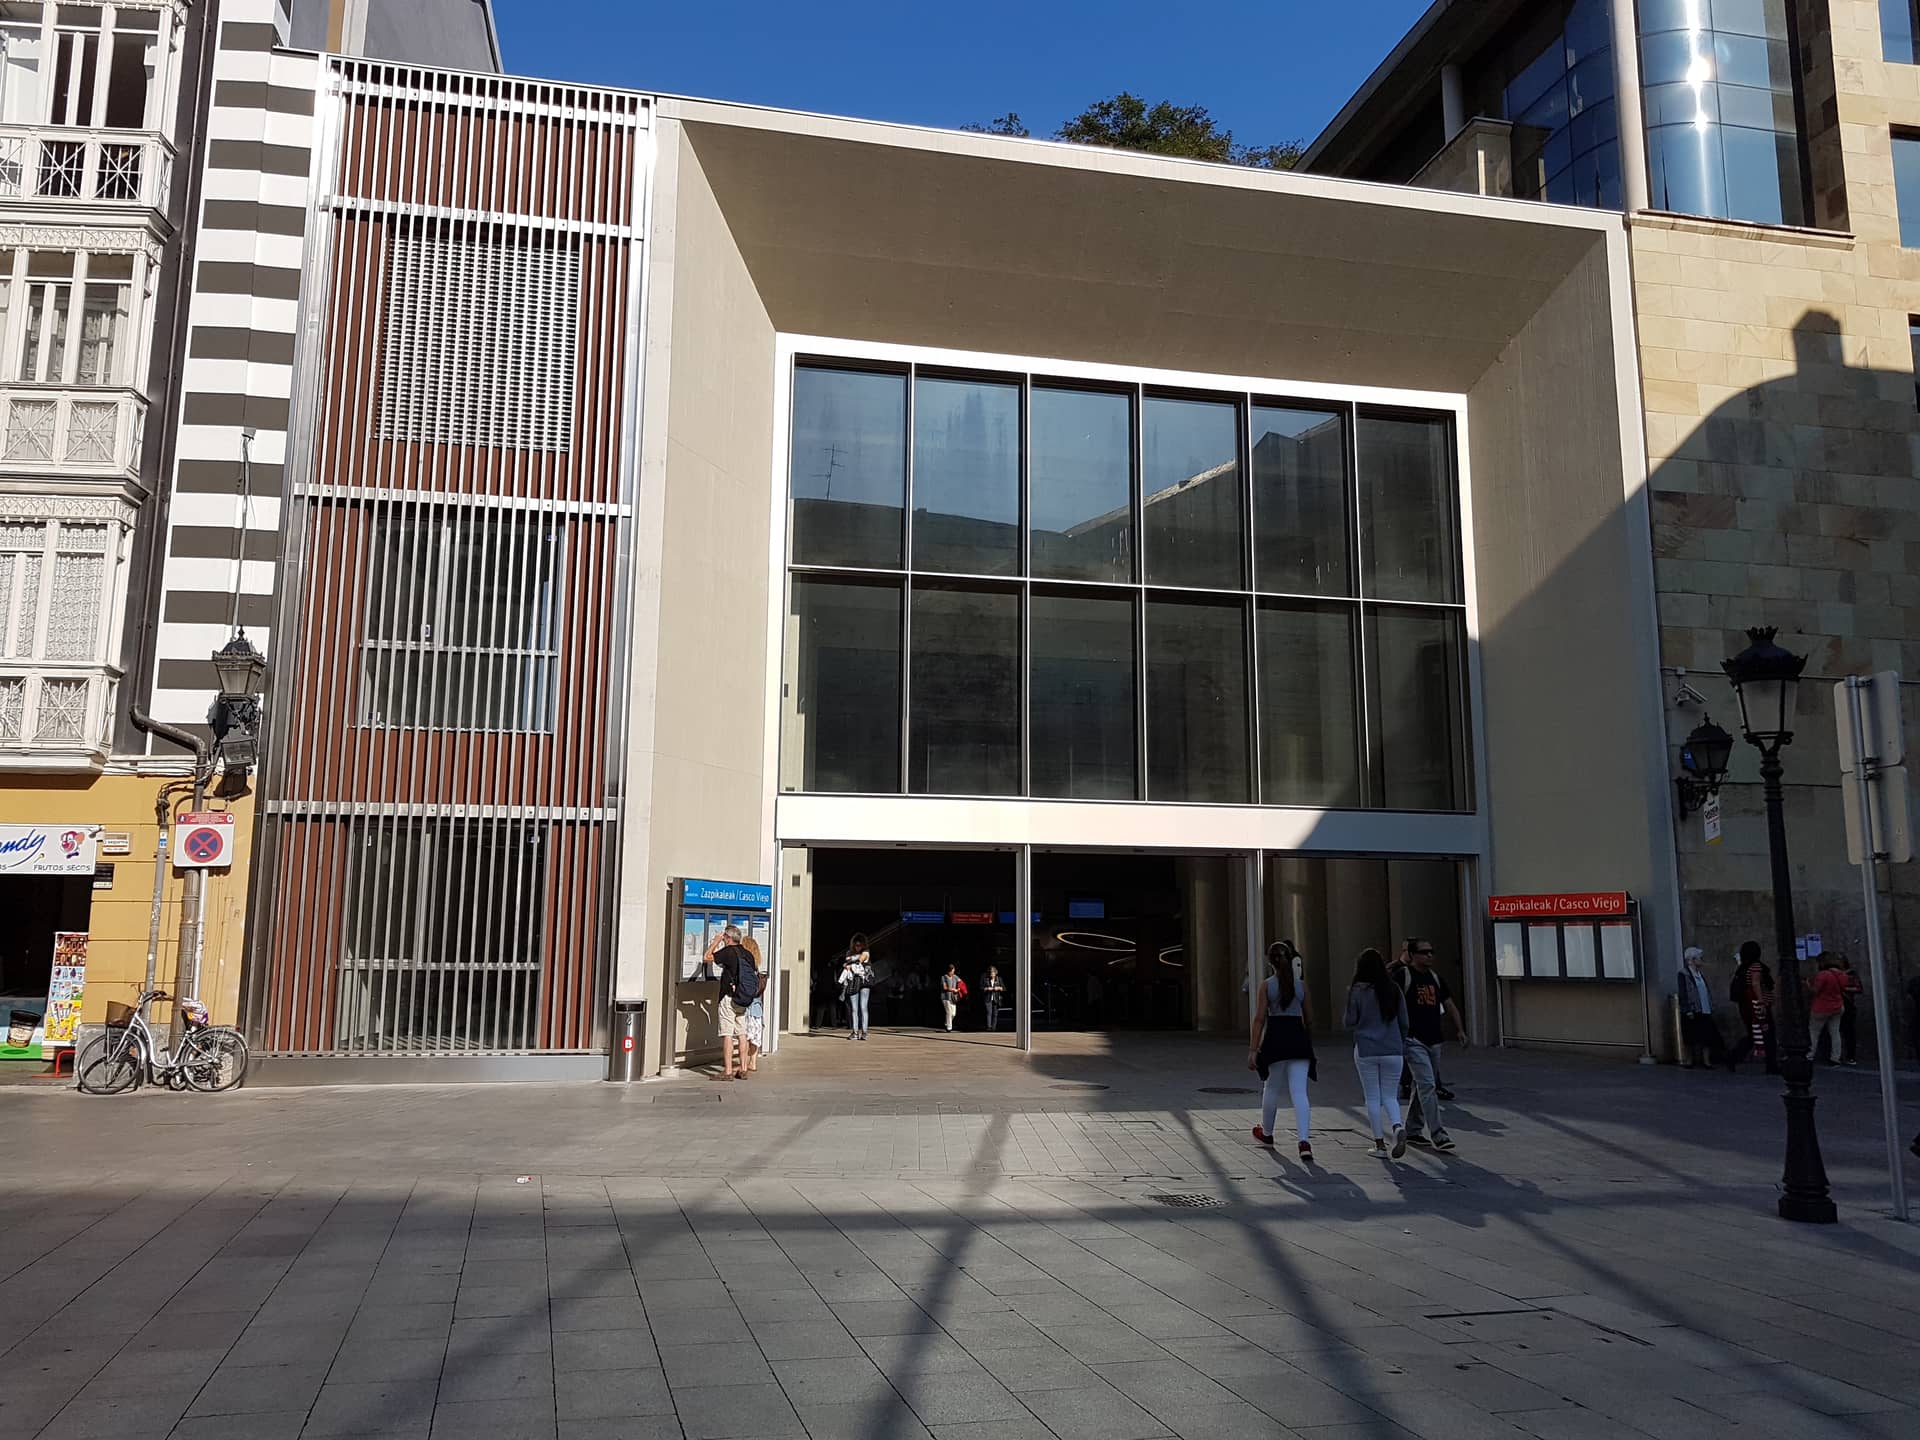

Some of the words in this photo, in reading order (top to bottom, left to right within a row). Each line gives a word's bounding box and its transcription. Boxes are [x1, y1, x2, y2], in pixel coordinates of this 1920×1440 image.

[0, 828, 46, 866] ndy
[66, 864, 91, 872] SECOS
[701, 887, 736, 901] Zazpikaleak
[739, 890, 755, 902] Casco
[756, 891, 770, 904] Viejo
[1494, 898, 1552, 913] Zazpikaleak
[1559, 897, 1590, 910] Casco
[1592, 896, 1620, 912] Viejo
